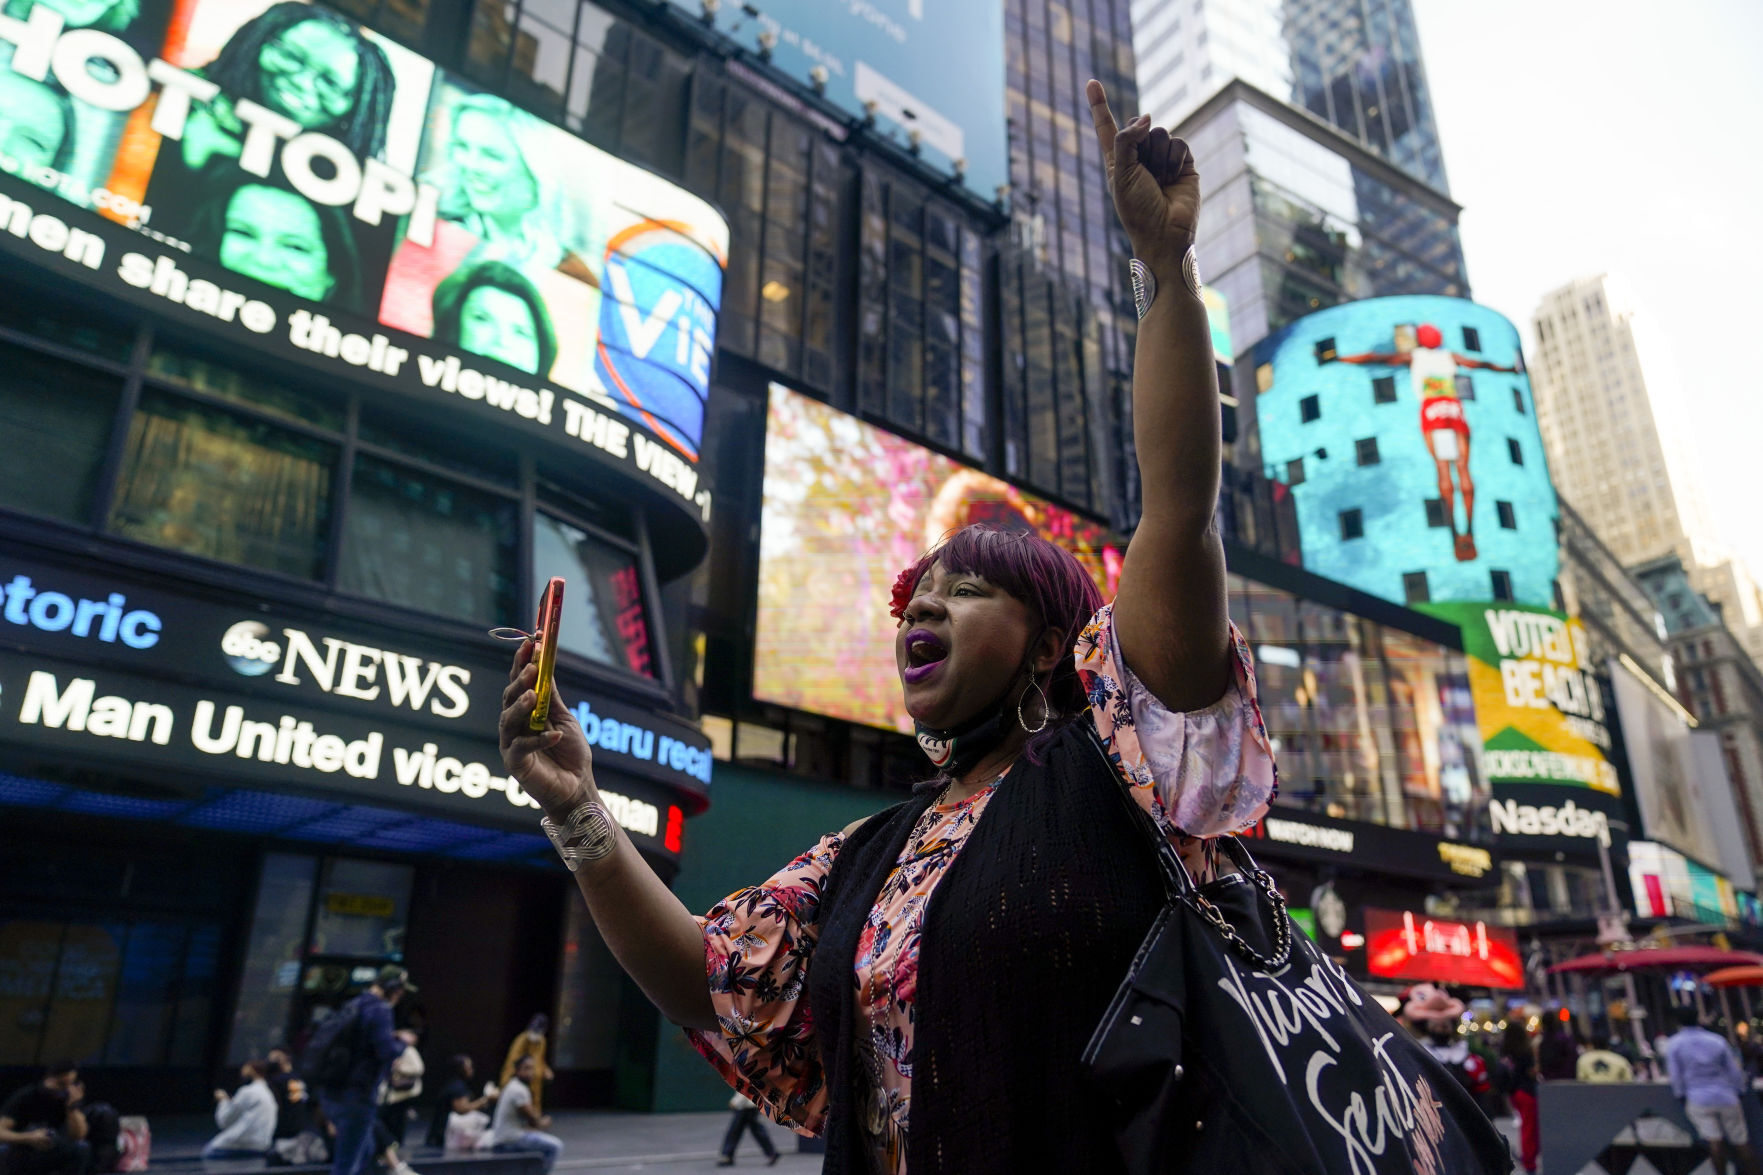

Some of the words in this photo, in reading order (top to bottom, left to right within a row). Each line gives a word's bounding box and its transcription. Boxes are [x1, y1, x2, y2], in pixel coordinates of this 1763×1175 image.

[0, 0, 221, 142] HOT
[118, 251, 277, 334] share
[288, 308, 408, 377] their
[417, 354, 554, 426] views!
[563, 398, 629, 459] THE
[0, 574, 163, 650] toric
[275, 628, 471, 718] NEWS
[19, 671, 174, 746] Man
[191, 700, 384, 780] United
[1489, 798, 1612, 849] Nasdaq
